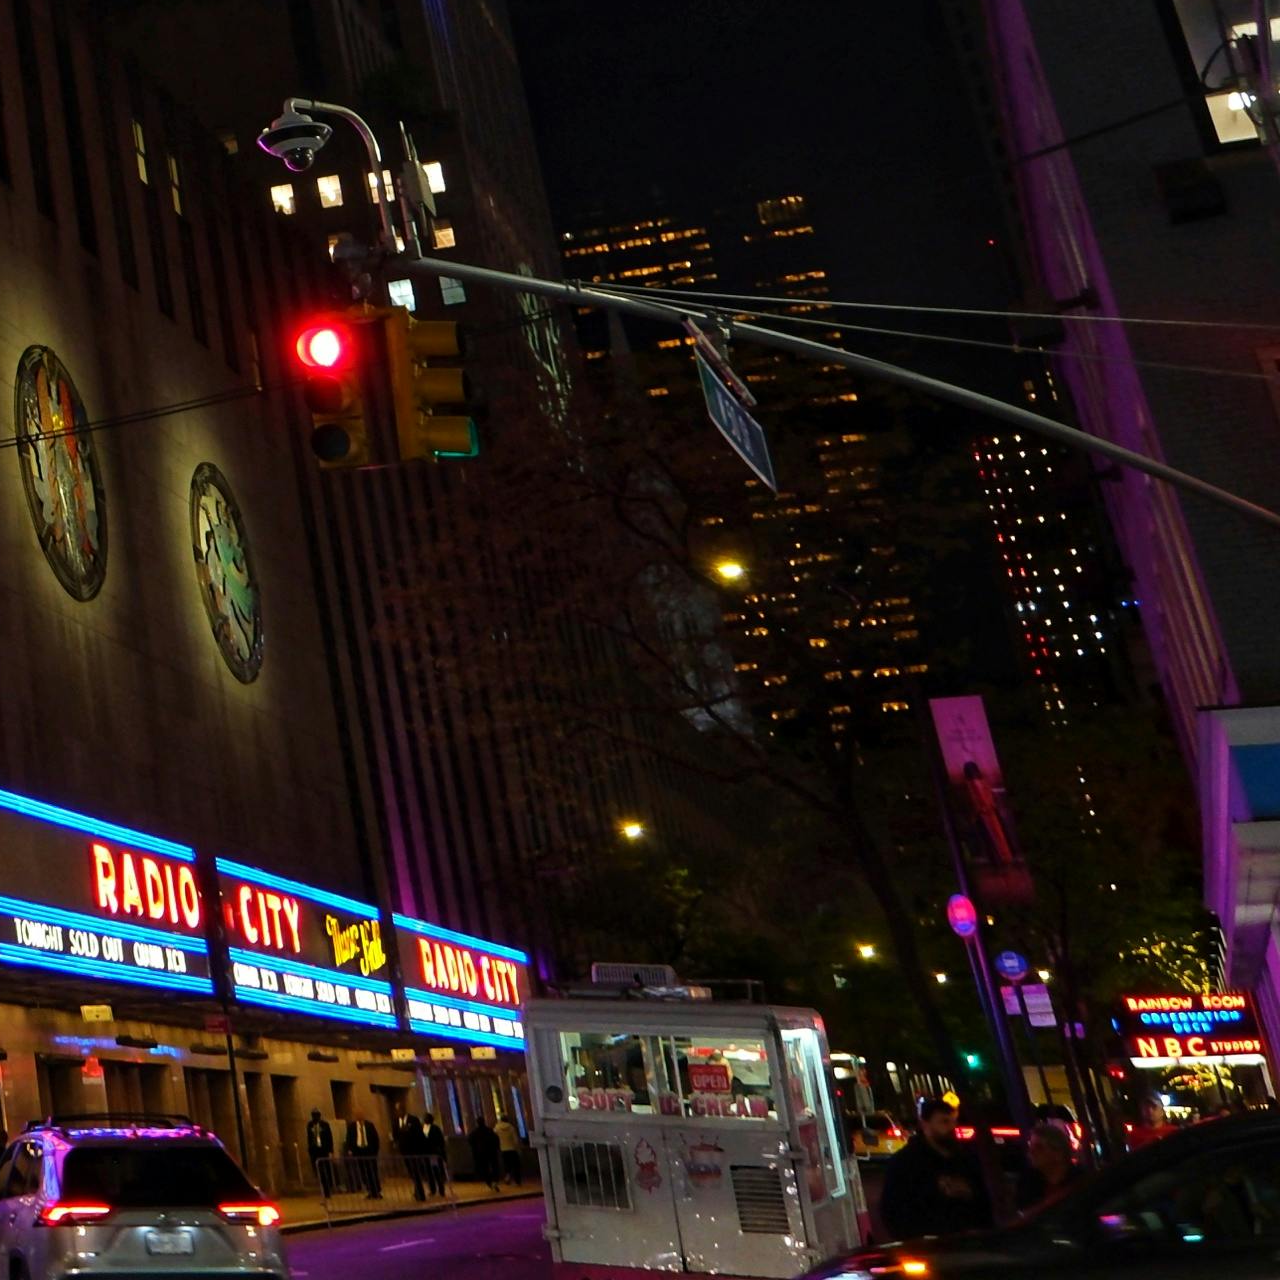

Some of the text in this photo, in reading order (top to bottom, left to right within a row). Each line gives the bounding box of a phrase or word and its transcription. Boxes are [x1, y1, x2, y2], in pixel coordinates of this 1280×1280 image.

[93, 843, 200, 928] RADIO
[240, 885, 301, 953] CITY
[418, 938, 477, 997] RADIO
[481, 956, 520, 1005] CITY
[14, 917, 63, 951] TONIGHT
[68, 928, 100, 958] SOLD
[102, 936, 124, 962] OUT
[1127, 995, 1246, 1011] RAINBOW ROOM
[1210, 1040, 1261, 1052] STUDIOS
[693, 1074, 728, 1089] OPEN
[577, 1086, 634, 1111] SOFT
